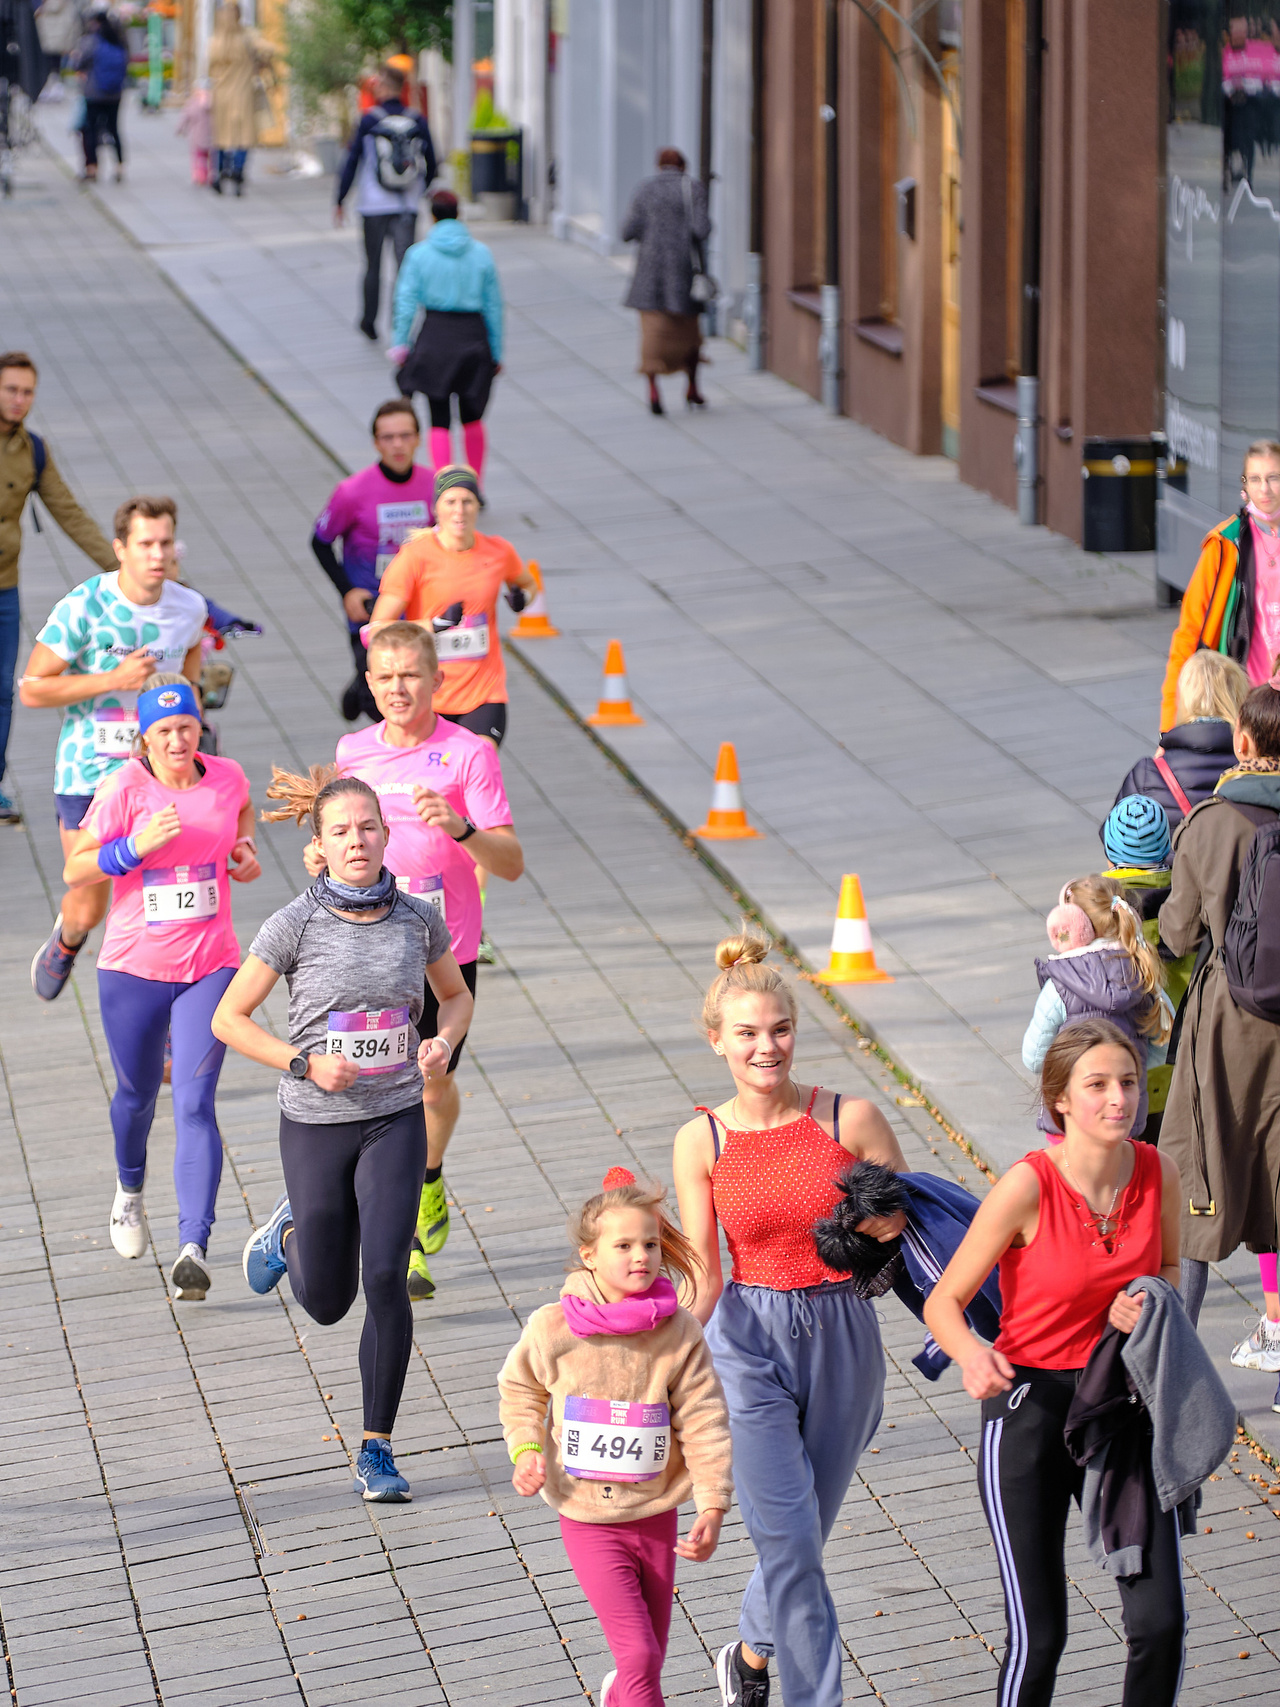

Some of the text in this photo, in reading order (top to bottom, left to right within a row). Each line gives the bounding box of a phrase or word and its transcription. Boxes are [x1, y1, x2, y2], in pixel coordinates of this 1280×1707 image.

[176, 891, 195, 909] 12
[352, 1038, 390, 1058] 394
[610, 1417, 626, 1425] RUN
[611, 1409, 628, 1418] PINK
[591, 1435, 643, 1461] 494
